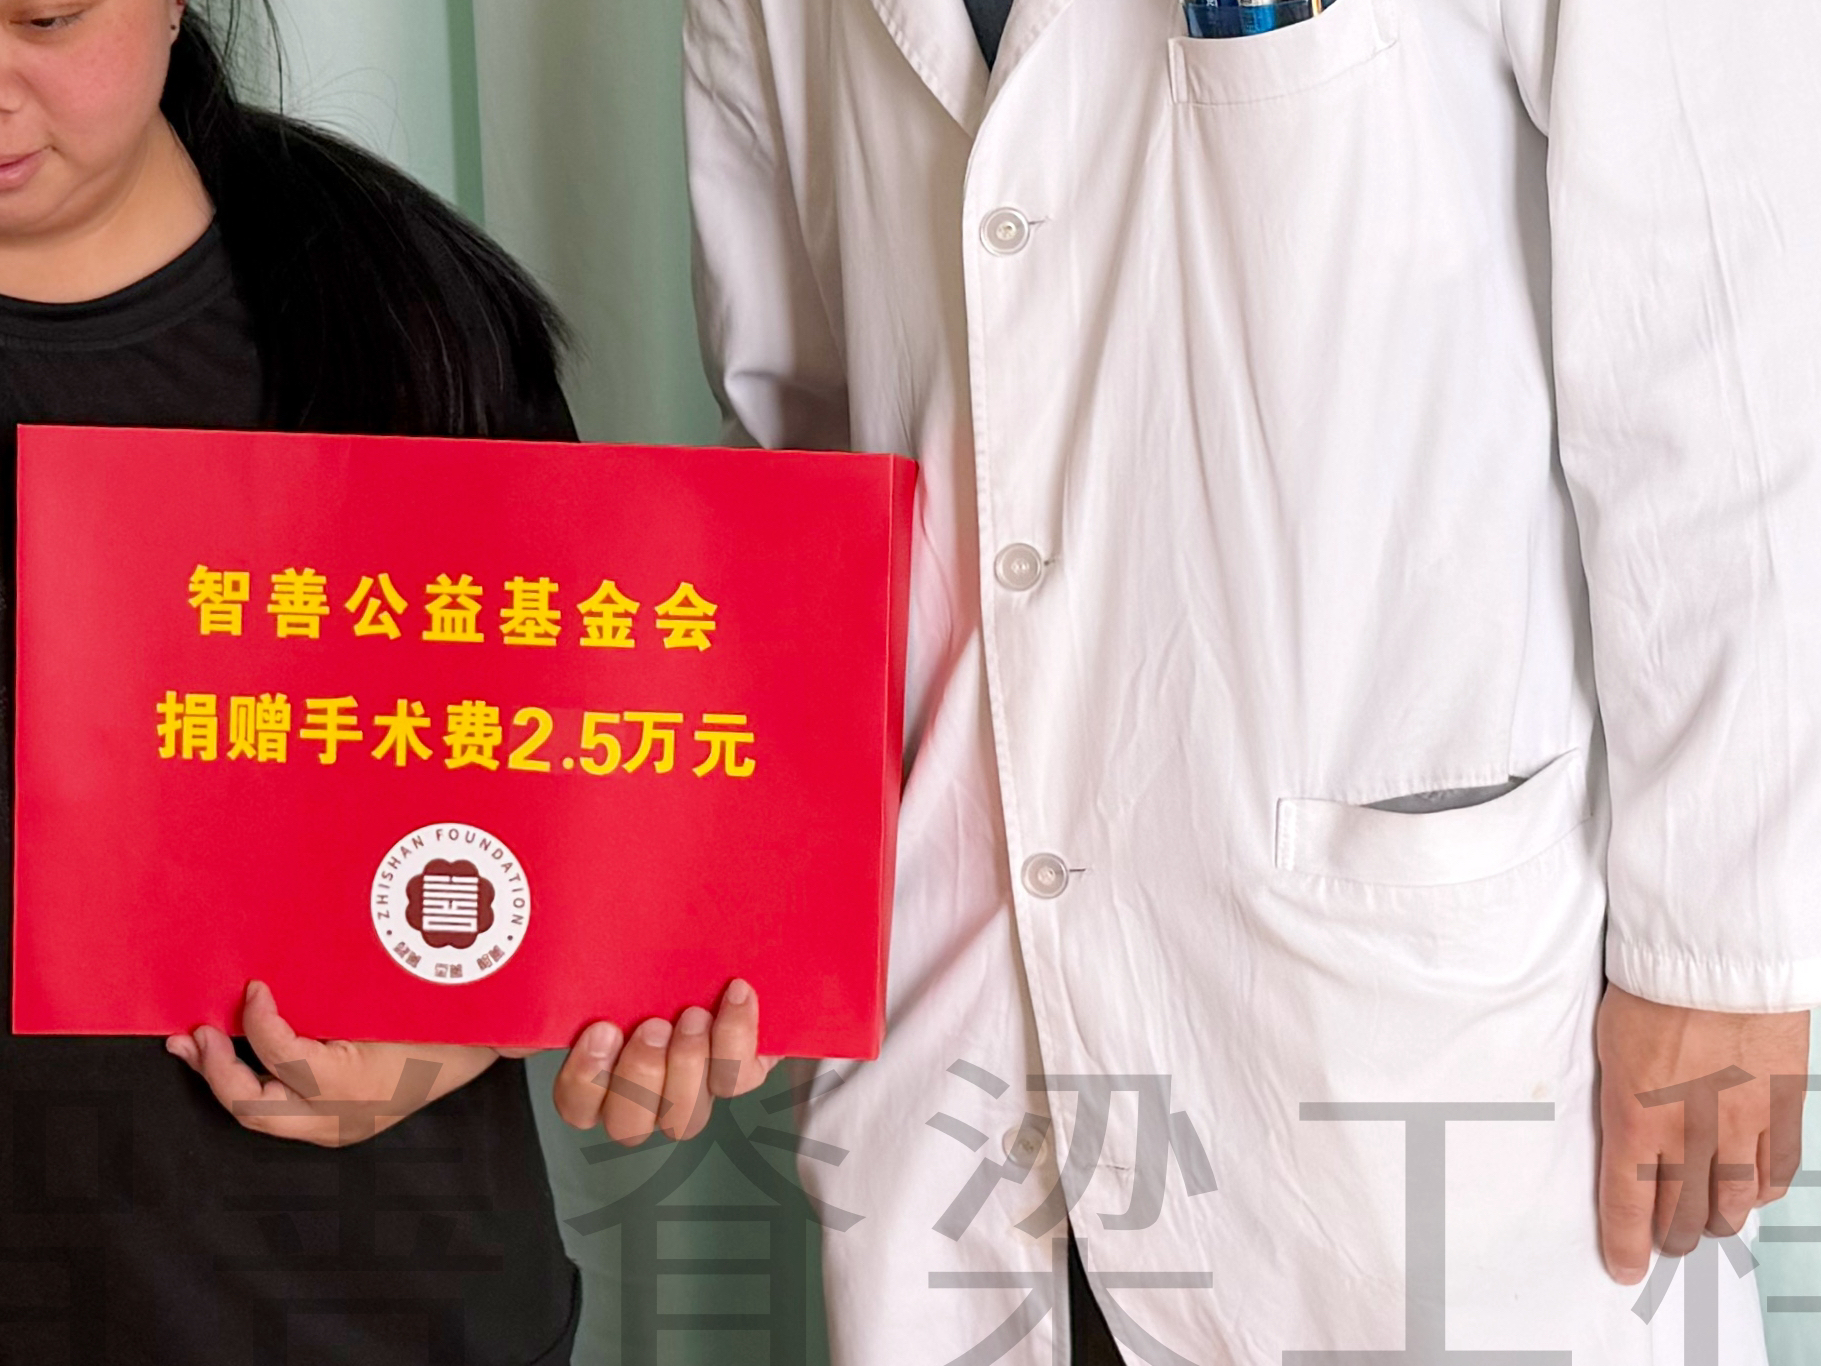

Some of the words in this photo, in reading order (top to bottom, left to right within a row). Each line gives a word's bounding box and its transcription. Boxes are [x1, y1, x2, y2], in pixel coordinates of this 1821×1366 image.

[188, 564, 719, 651] 智善公益基金会
[156, 690, 757, 777] 捐赠手术费2.5万元
[376, 835, 424, 920] ZHISHAN
[435, 828, 526, 926] FOUNDATION
